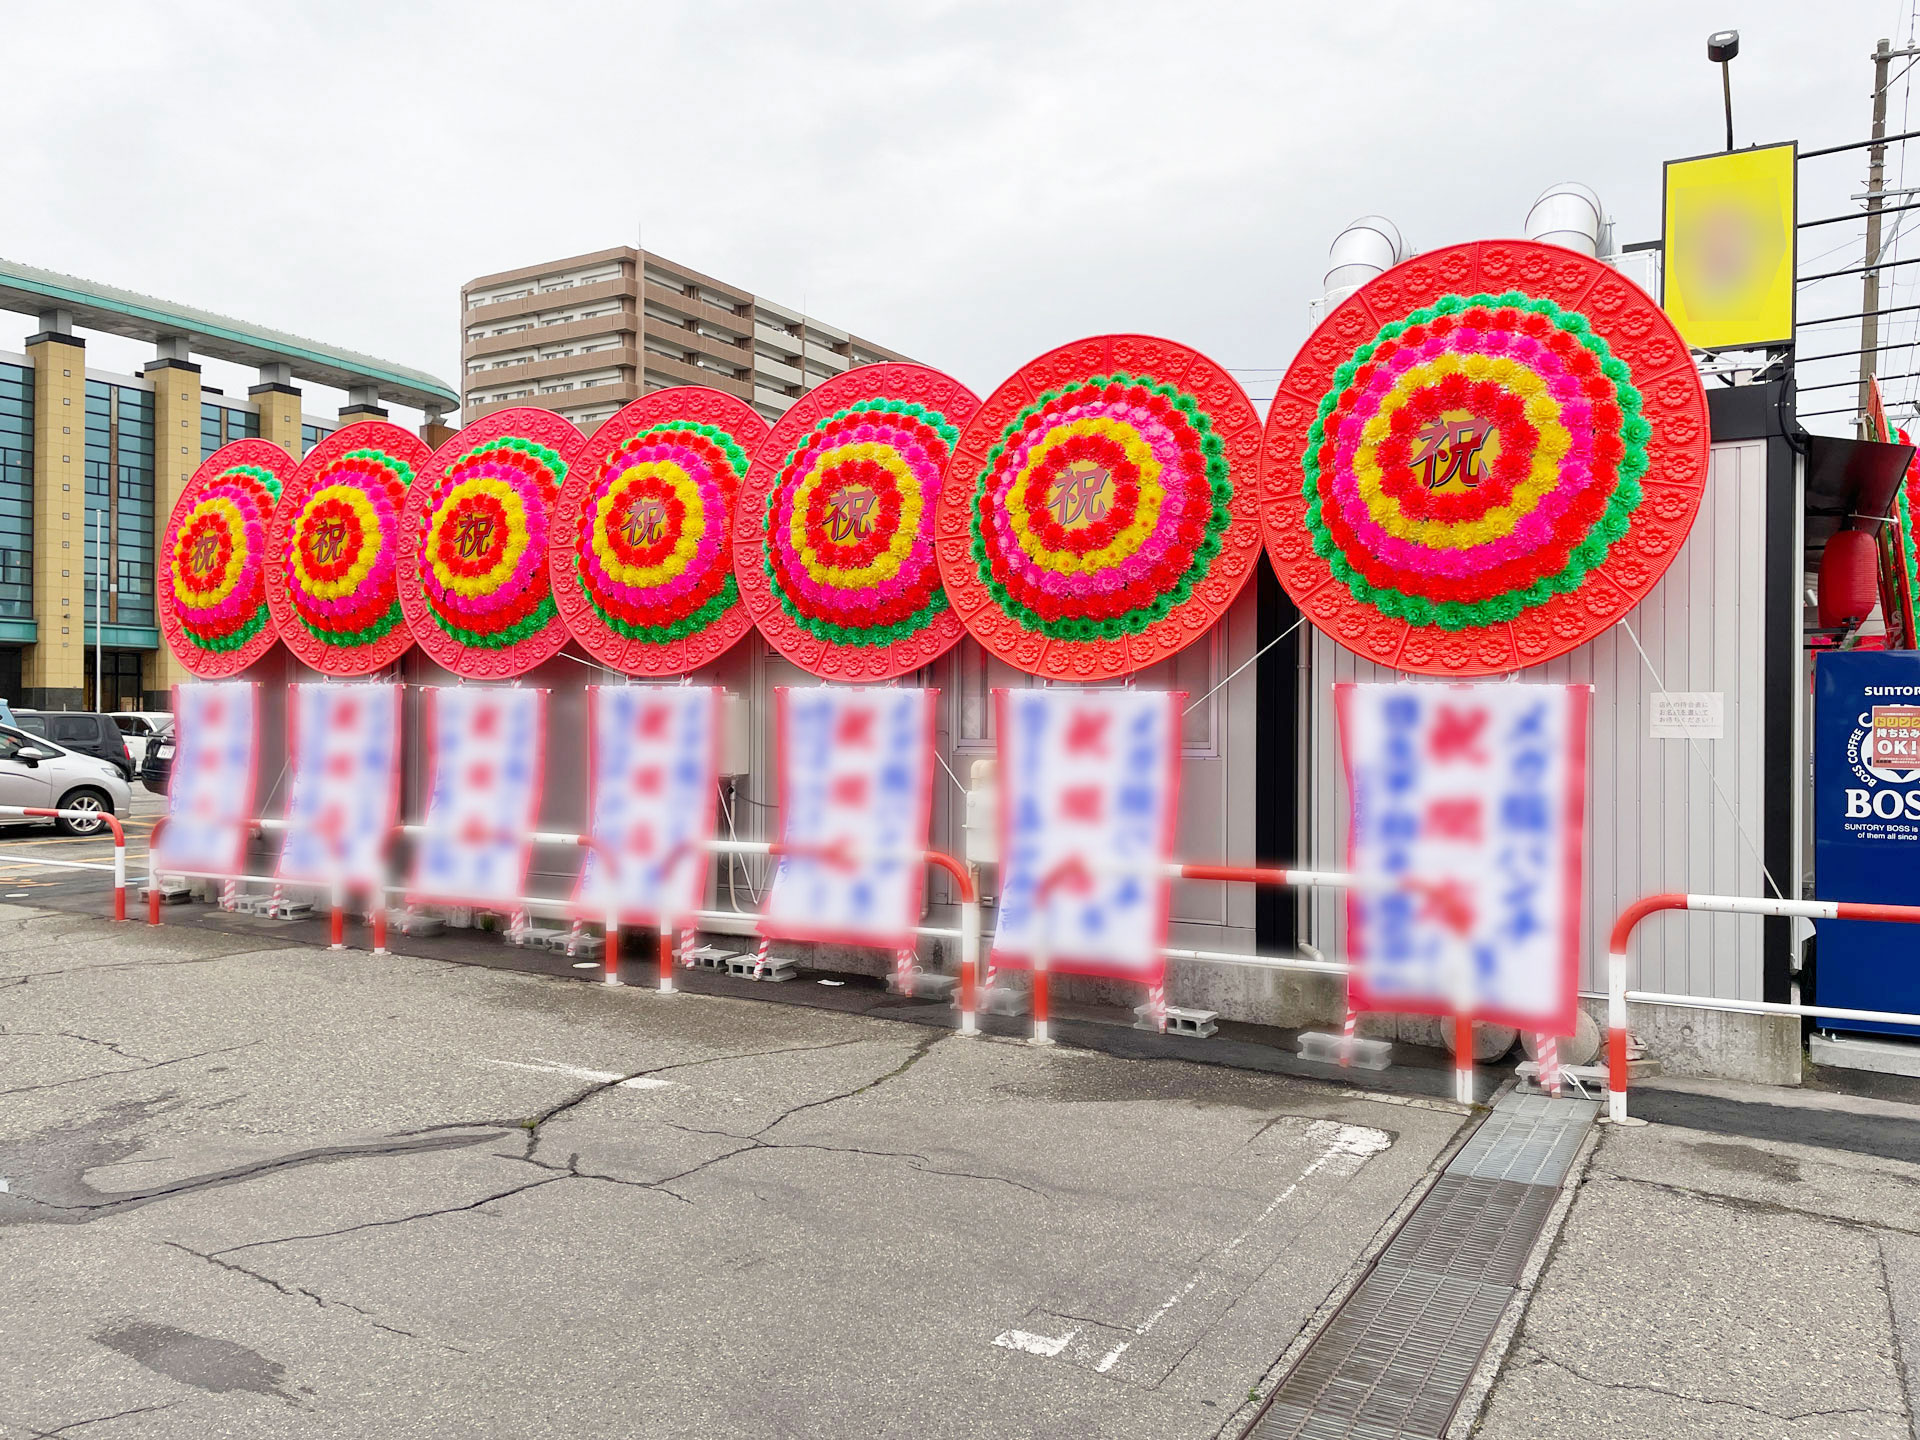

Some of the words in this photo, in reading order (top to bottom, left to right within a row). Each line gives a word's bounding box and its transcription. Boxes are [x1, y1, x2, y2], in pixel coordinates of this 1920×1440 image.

[1408, 416, 1494, 490] 祝
[822, 488, 877, 542] 祝
[1048, 467, 1110, 525] 祝
[311, 520, 347, 564] 祝
[454, 514, 494, 558] 祝
[620, 499, 665, 547] 祝
[191, 533, 219, 573] 祝
[1876, 717, 1920, 727] ドリンク
[1876, 728, 1920, 738] 持ち込み
[1847, 728, 1864, 764] COFFEE
[1877, 740, 1917, 755] OK!
[1852, 764, 1877, 788] BOSS
[1844, 823, 1885, 831] SUNTORY
[1886, 824, 1910, 832] BOSS
